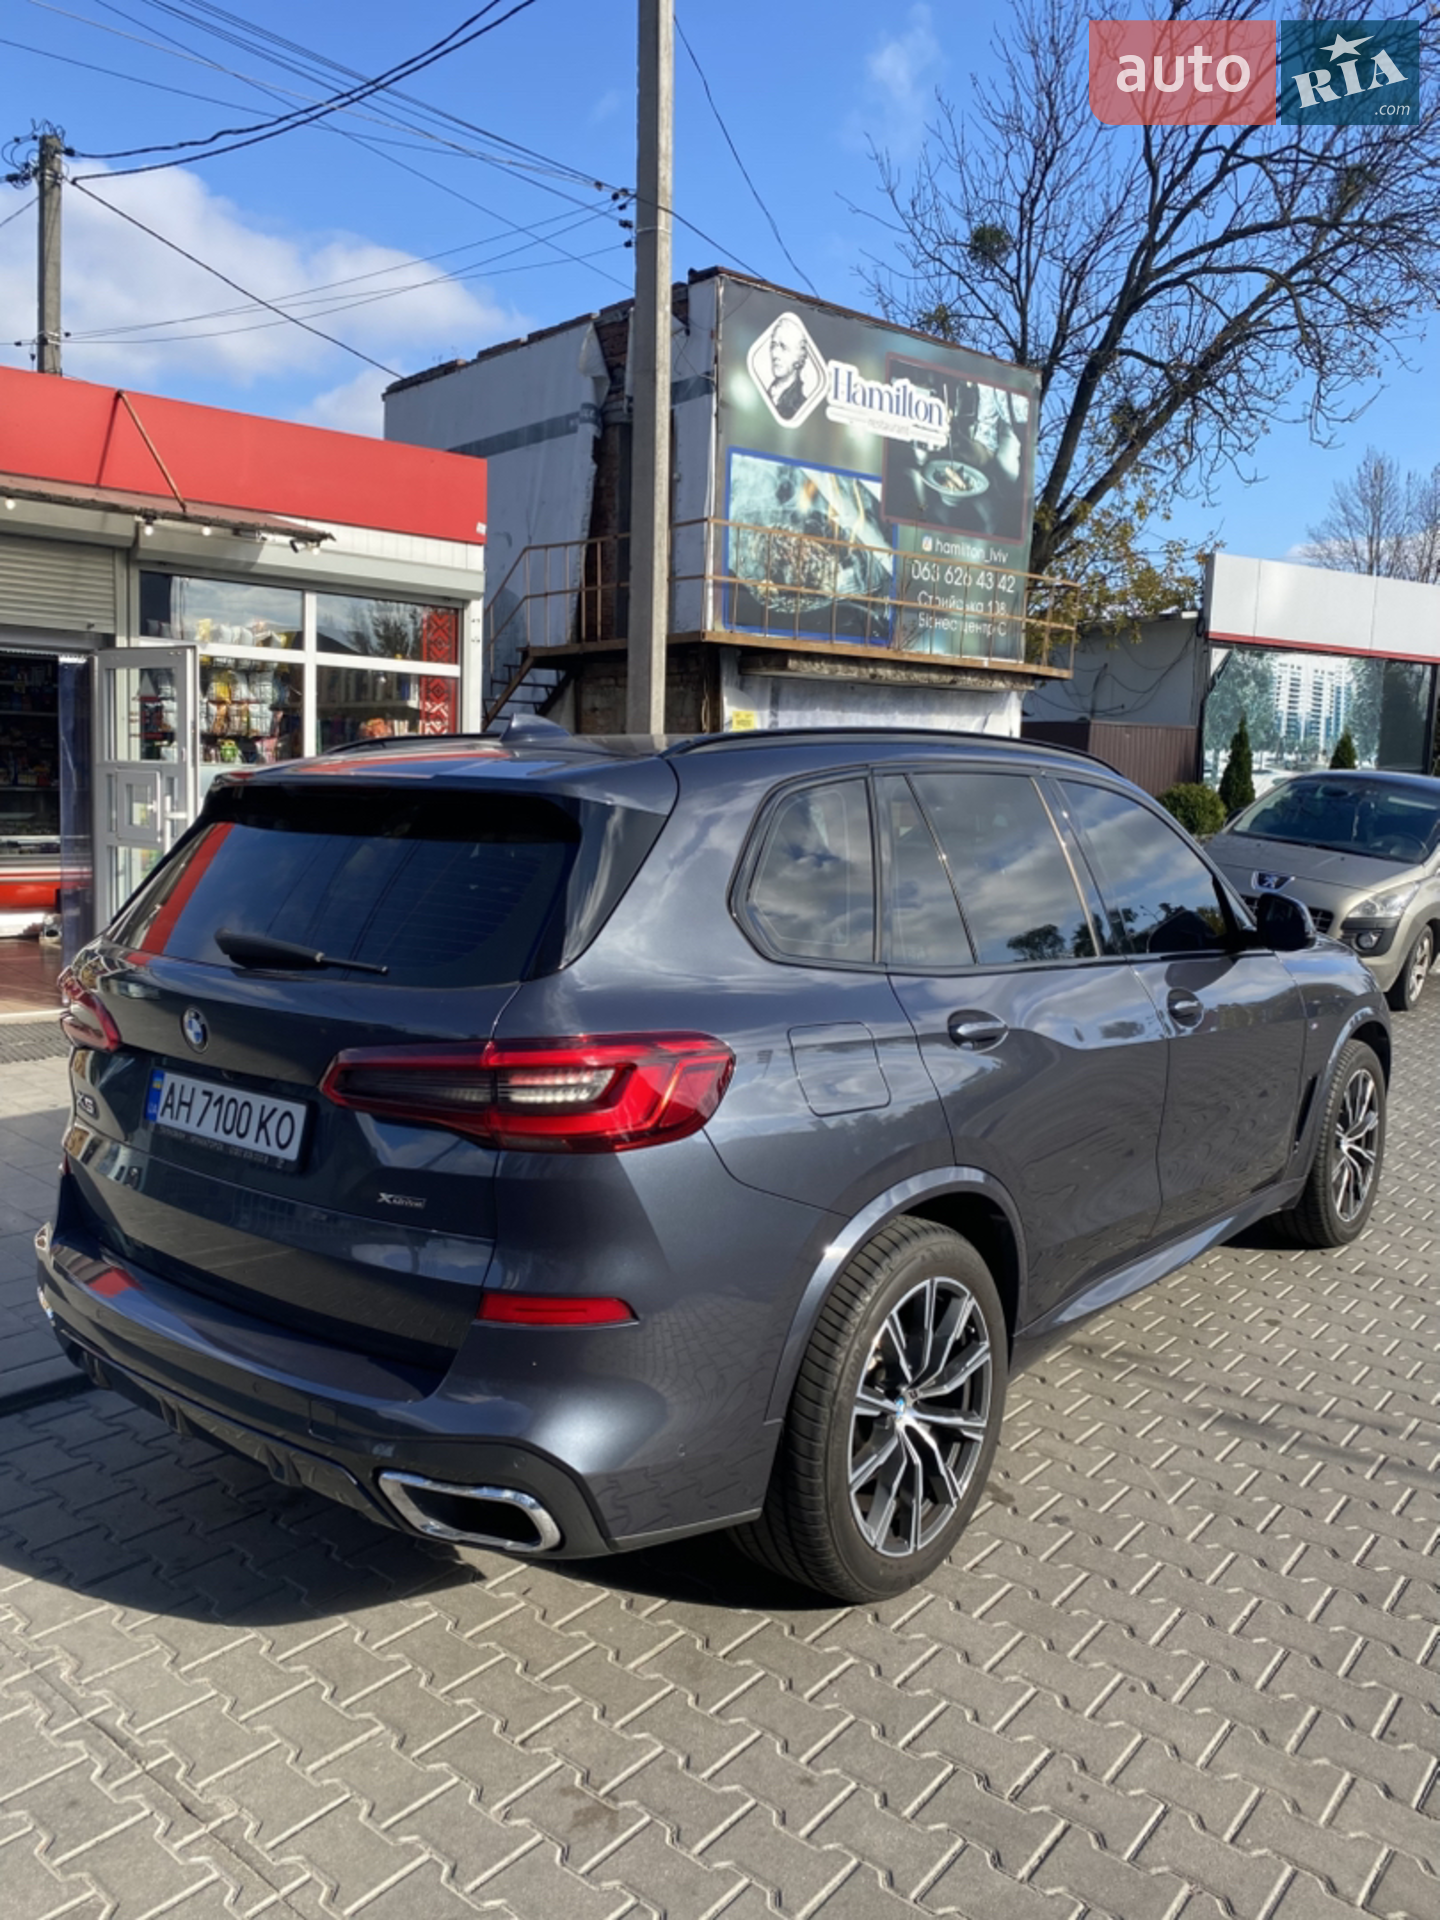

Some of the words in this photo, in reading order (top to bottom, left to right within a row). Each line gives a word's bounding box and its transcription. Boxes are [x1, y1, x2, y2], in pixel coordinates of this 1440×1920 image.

[832, 367, 943, 427] Hamilton
[911, 559, 940, 582] 063
[944, 565, 972, 587] 626
[976, 570, 994, 590] 43
[997, 573, 1016, 593] 42
[160, 1082, 195, 1124] AH
[196, 1089, 253, 1139] 7100
[254, 1104, 296, 1150] KO
